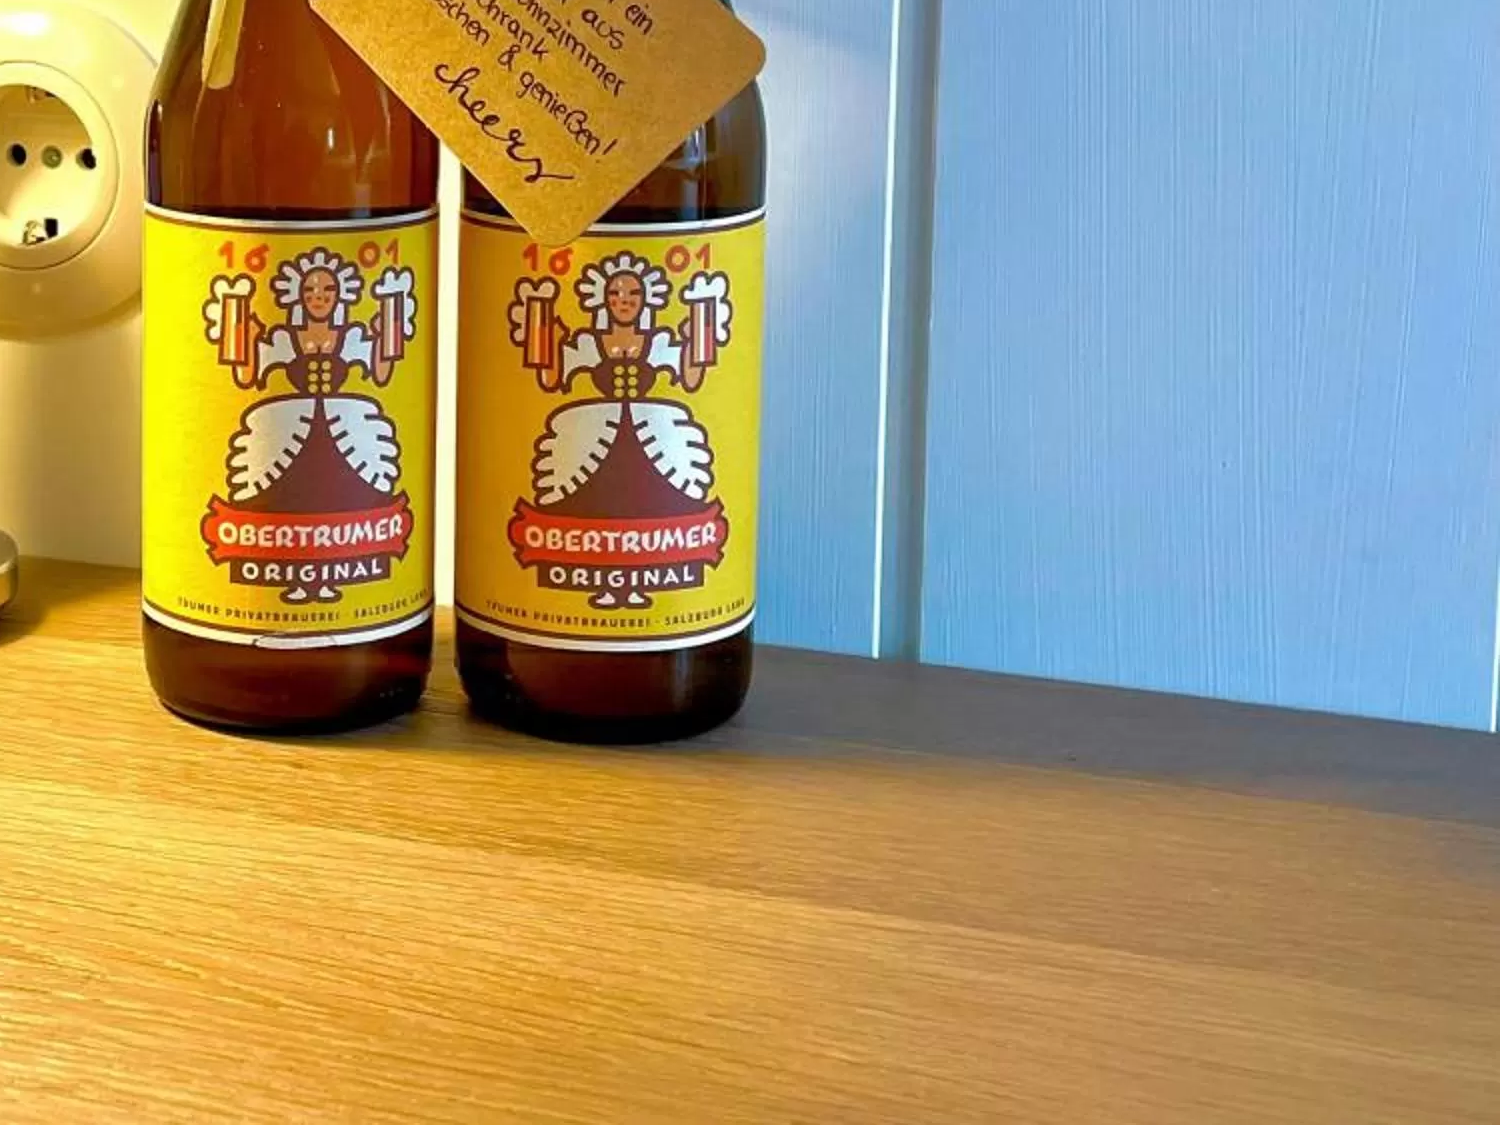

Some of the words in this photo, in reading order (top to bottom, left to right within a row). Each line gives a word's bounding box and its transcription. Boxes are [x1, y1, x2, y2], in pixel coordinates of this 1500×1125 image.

[581, 8, 624, 50] aus
[625, 3, 653, 35] ein
[497, 44, 521, 72] &
[217, 239, 270, 273] 16
[523, 242, 574, 276] 16
[217, 512, 403, 549] OBERTRUMER
[524, 521, 718, 554] OBERTRUMER
[241, 557, 384, 583] ORIGINAL
[549, 564, 695, 589] ORIGINAL
